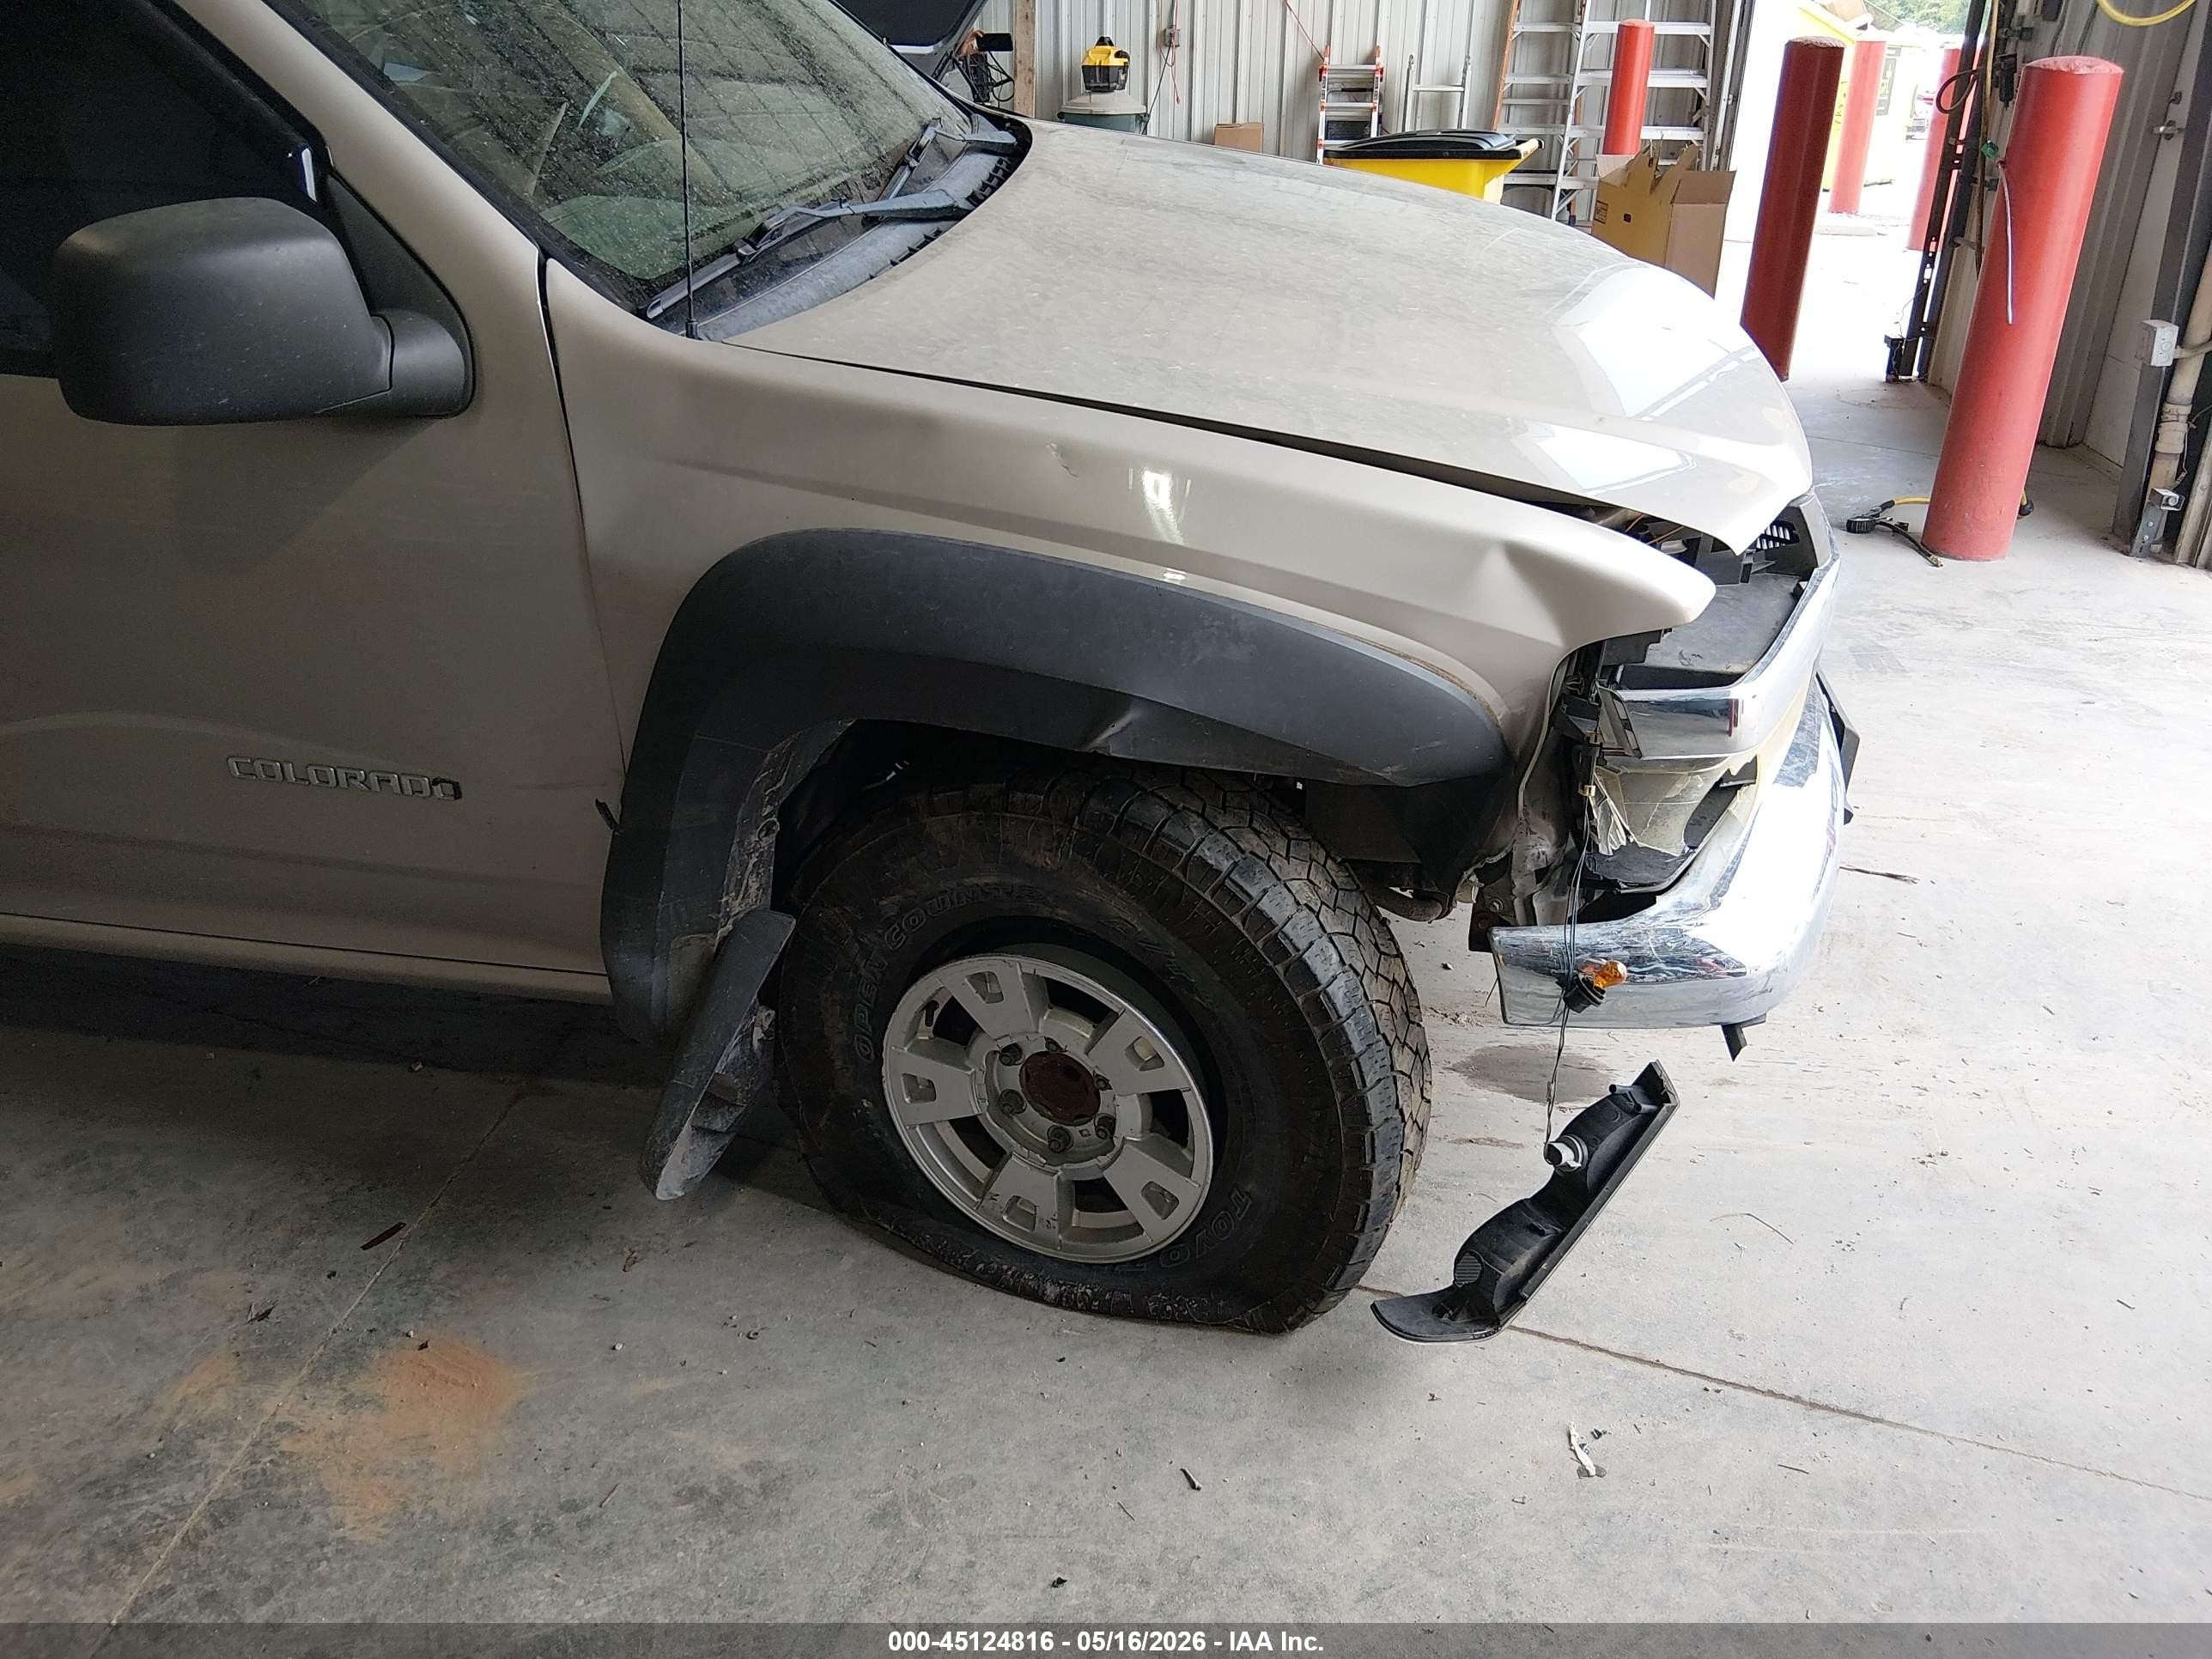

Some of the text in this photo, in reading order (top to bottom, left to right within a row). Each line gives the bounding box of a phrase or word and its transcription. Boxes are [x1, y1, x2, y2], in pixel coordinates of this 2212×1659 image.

[227, 756, 462, 800] COLORADO
[854, 950, 890, 1063] OPEN
[1159, 1187, 1251, 1268] TOYO
